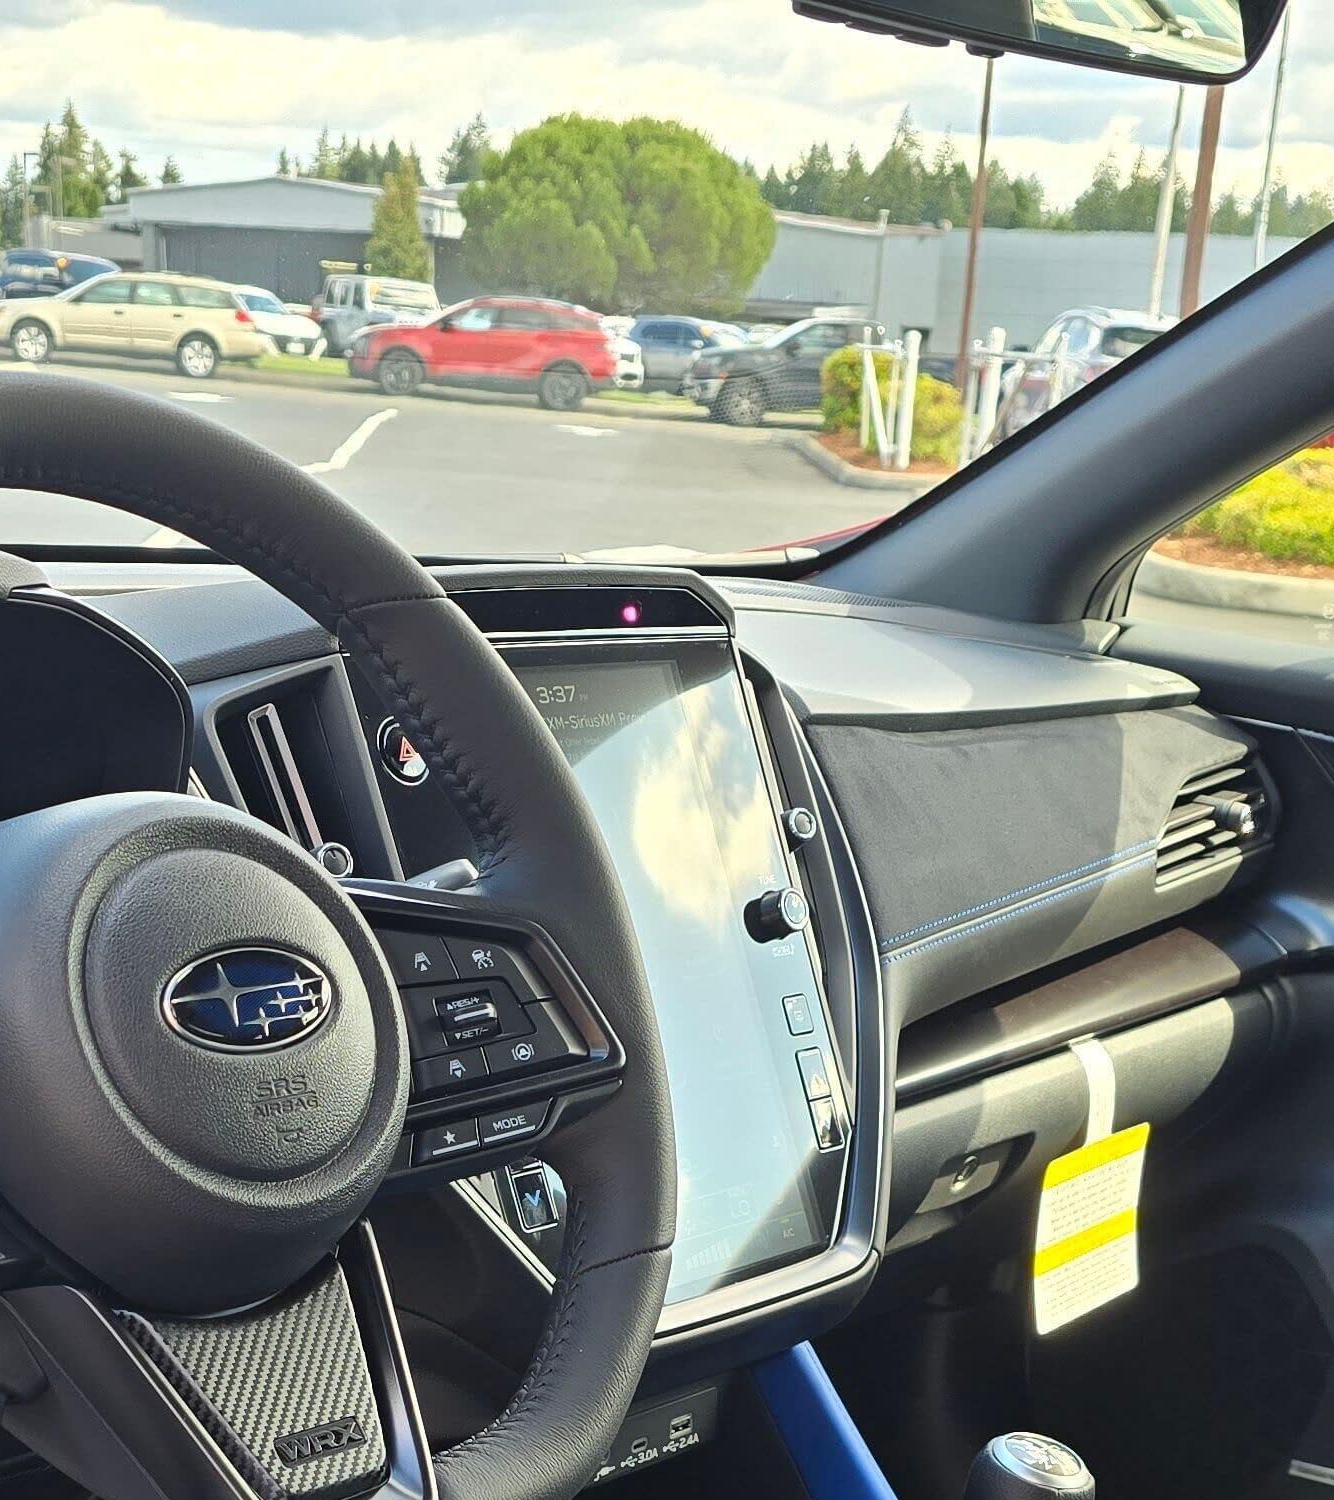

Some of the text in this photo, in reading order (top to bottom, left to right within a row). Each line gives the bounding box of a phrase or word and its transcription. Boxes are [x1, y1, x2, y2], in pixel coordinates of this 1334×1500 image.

[536, 685, 575, 704] 3:37
[252, 1074, 308, 1099] SRS
[252, 1095, 319, 1120] AIRBAG
[493, 1114, 527, 1131] MODE
[275, 1420, 364, 1462] WRX
